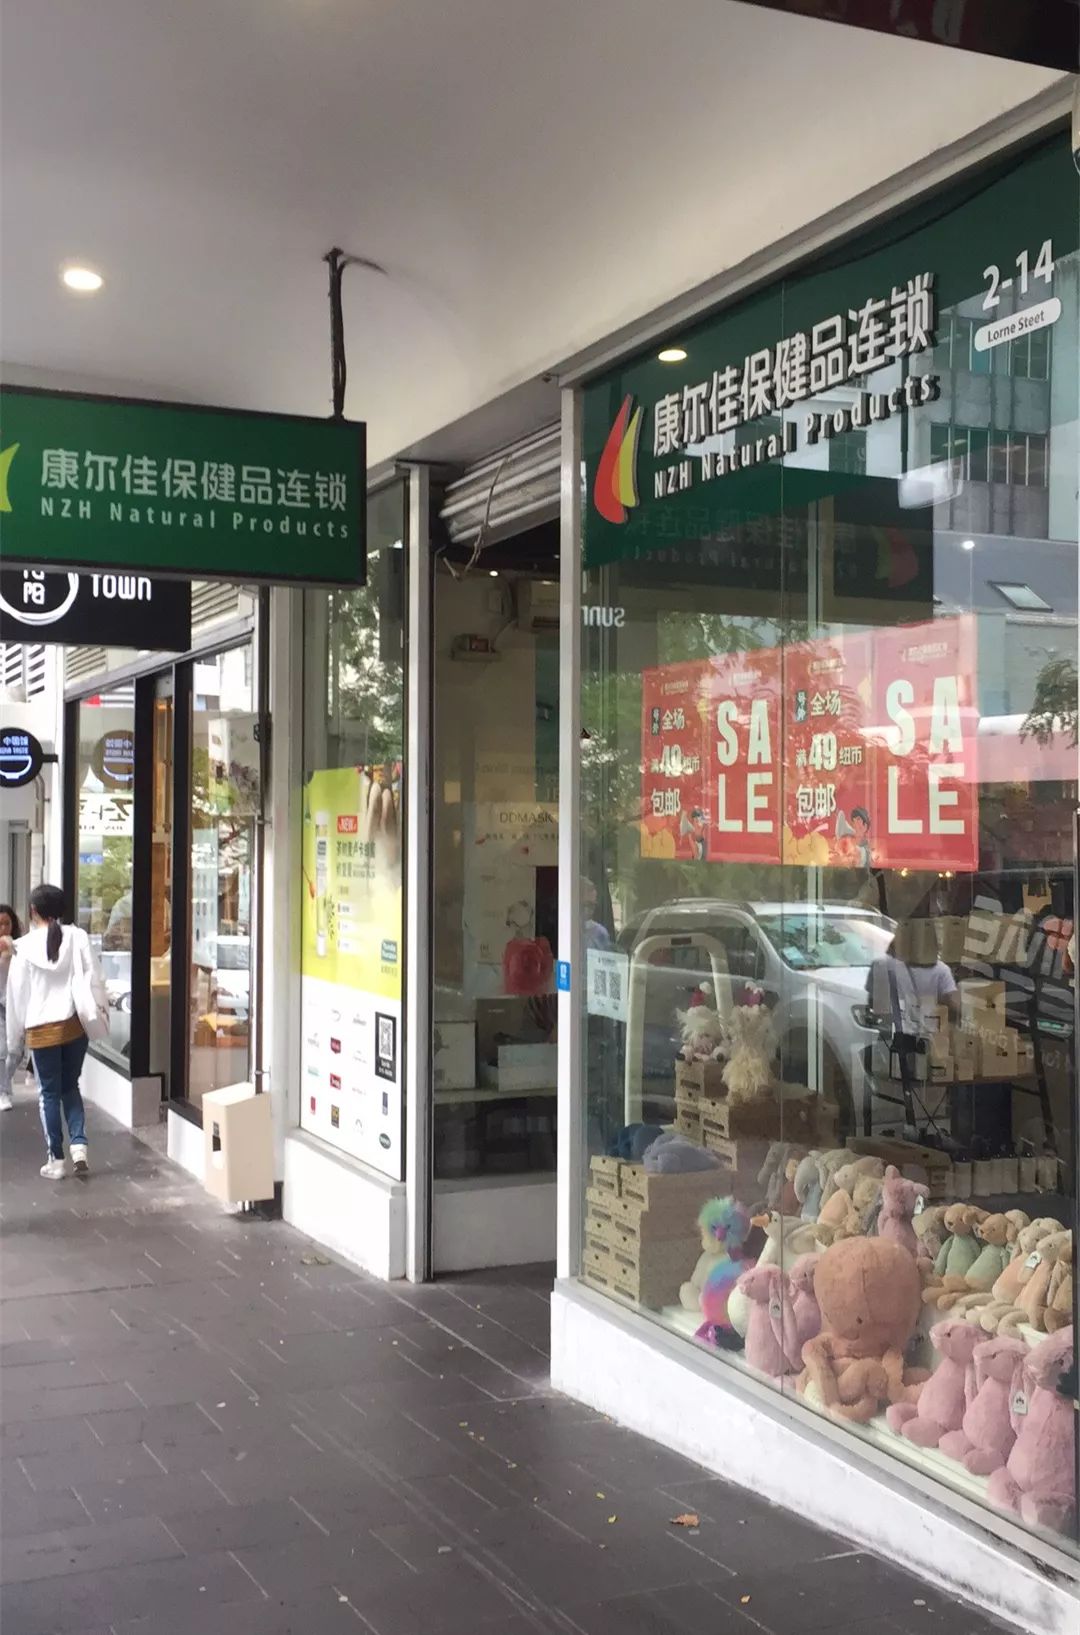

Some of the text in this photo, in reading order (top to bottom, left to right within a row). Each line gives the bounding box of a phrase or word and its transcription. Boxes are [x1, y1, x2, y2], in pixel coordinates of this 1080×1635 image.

[983, 239, 1055, 311] 2-14
[987, 310, 1045, 343] Lorne Steet
[653, 271, 932, 456] 康尔佳保健品连锁
[654, 374, 934, 498] NZH Natural Products
[40, 448, 347, 511] 康尔佳保健品连锁
[41, 497, 348, 538] NZH Natural Products
[662, 708, 685, 731] 全场
[810, 690, 841, 717] 全场
[650, 788, 681, 818] 包邮
[796, 784, 836, 819] 包邮
